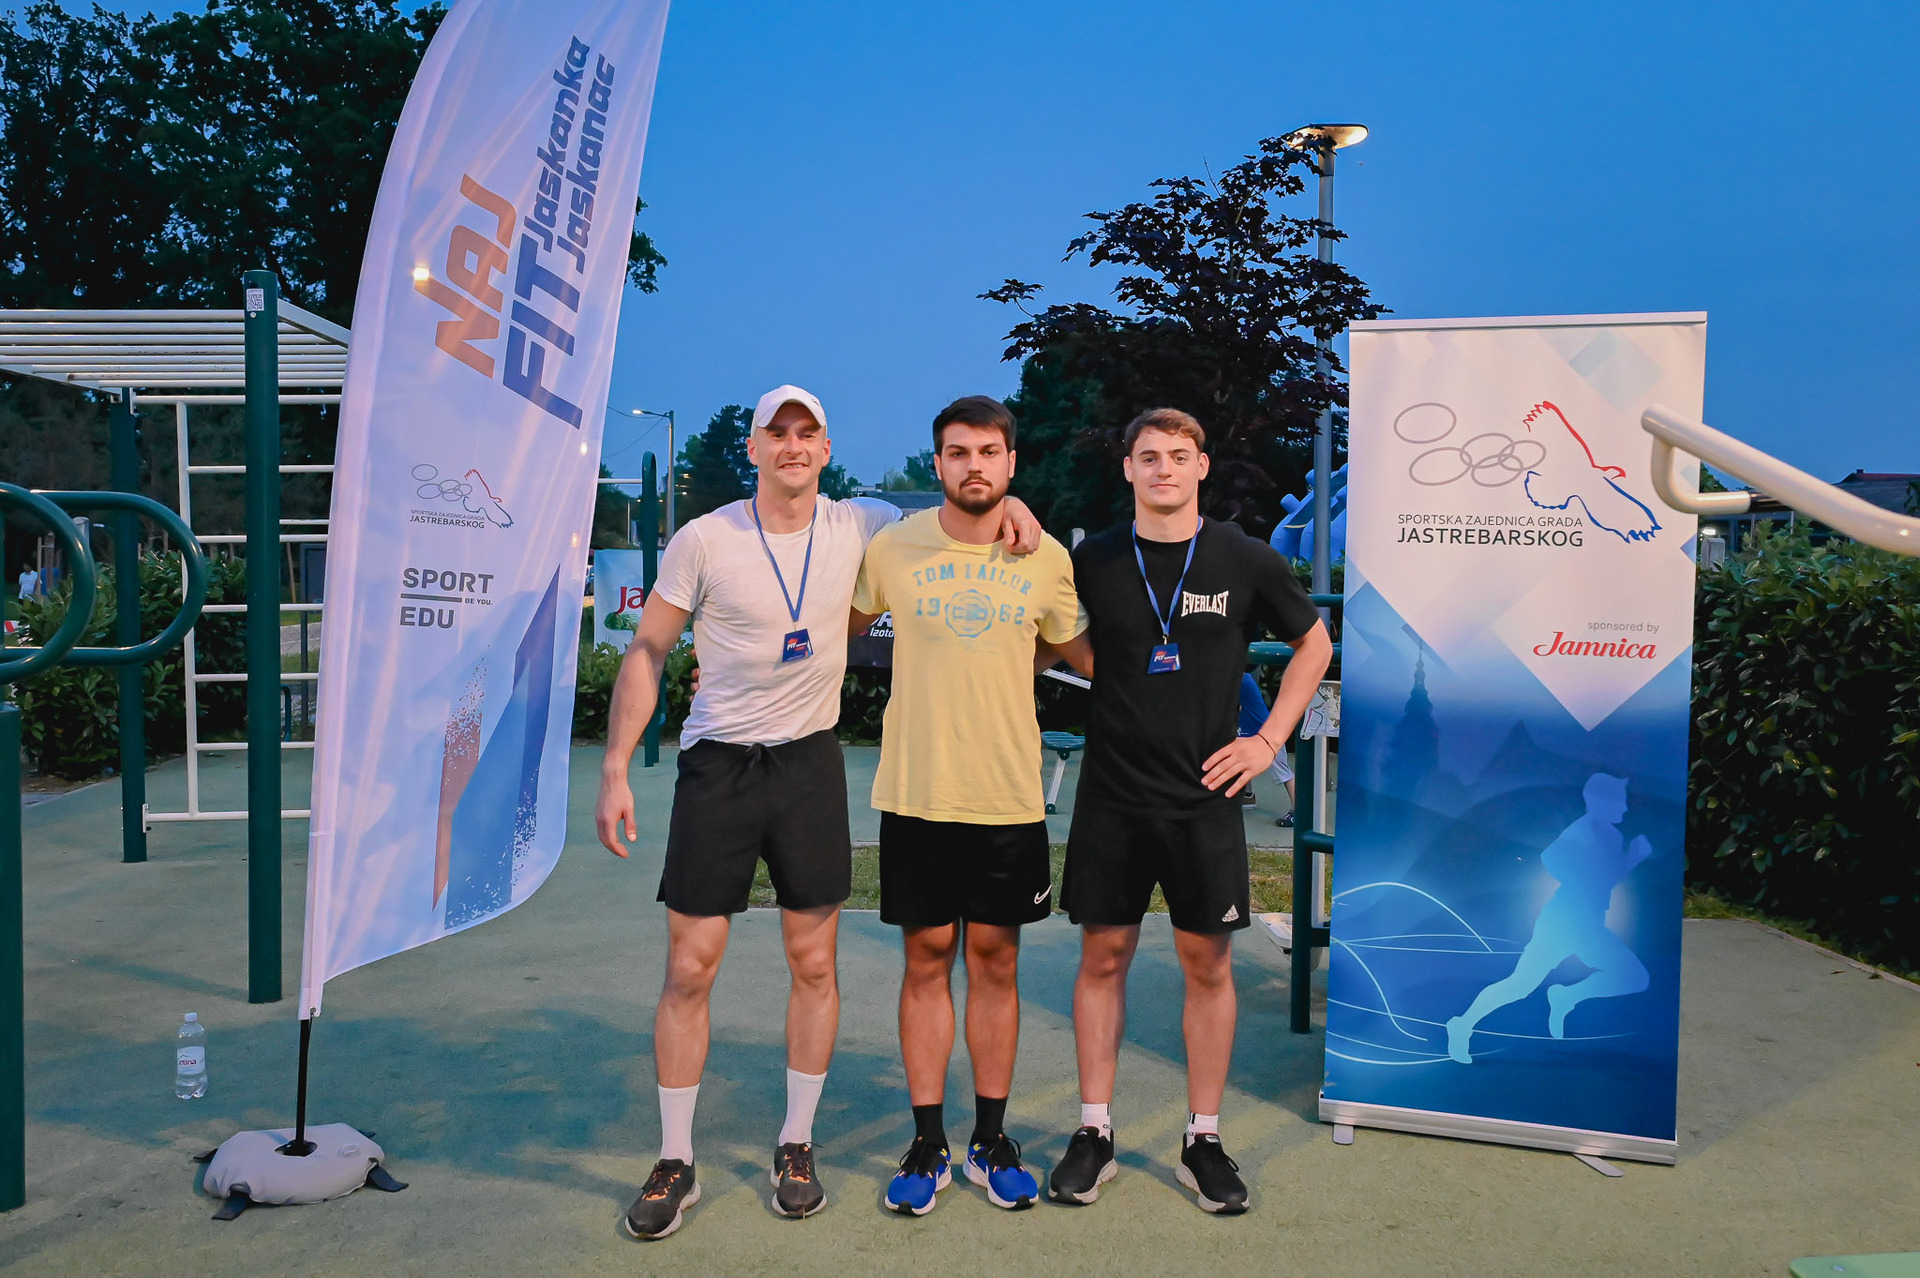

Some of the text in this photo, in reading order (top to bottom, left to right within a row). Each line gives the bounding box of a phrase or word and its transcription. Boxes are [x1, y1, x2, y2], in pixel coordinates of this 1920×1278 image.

[523, 35, 590, 253] Jaskanka
[557, 53, 615, 274] Jaskanac
[414, 173, 516, 379] NAJ
[503, 232, 582, 429] FIT
[410, 515, 485, 529] JASTREBARSKOG
[1397, 514, 1583, 527] SPORTSKA ZAJEDNICA GRADA
[1397, 527, 1583, 547] JASTREBARSKOG
[402, 567, 494, 594] SPORT
[912, 563, 1032, 595] TOM TAILOR
[916, 597, 1025, 625] 19 62
[1181, 590, 1229, 617] EVERLAST
[400, 606, 454, 629] EDU
[1587, 621, 1659, 634] sponsored by
[1533, 631, 1656, 659] Jamnica
